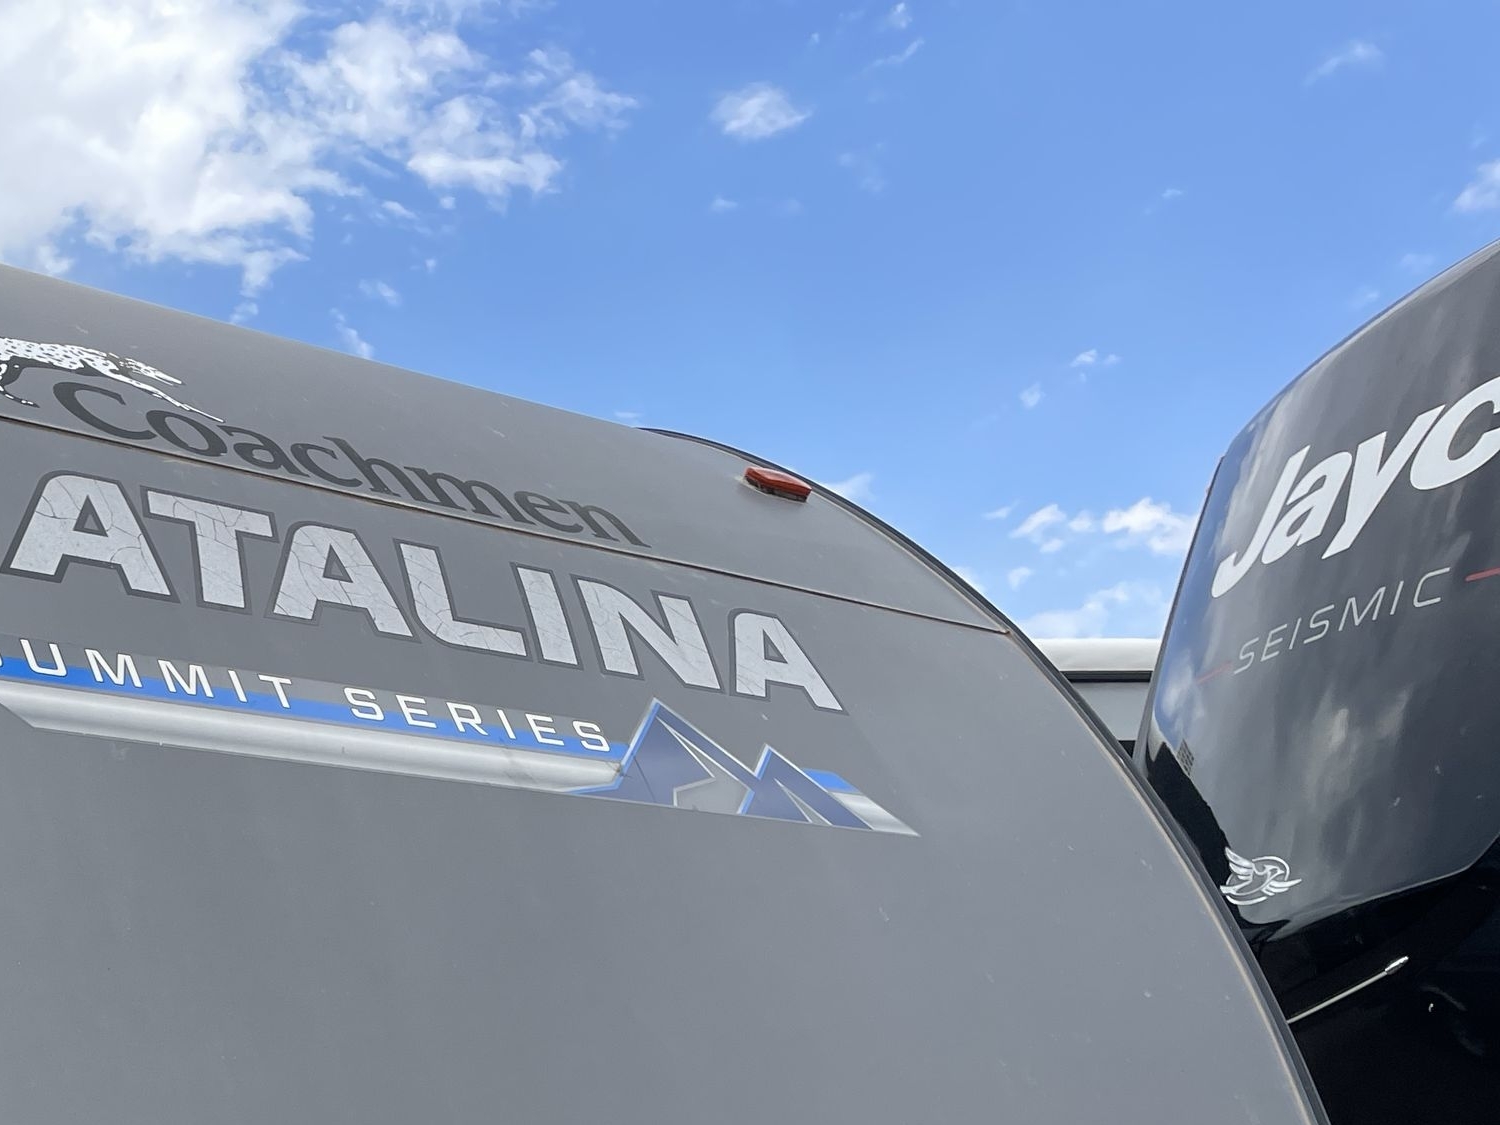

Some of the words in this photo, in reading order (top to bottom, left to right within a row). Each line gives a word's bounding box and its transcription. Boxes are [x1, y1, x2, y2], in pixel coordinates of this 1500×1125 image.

[52, 382, 652, 550] Coachmen
[1233, 567, 1452, 676] SEISMIC
[342, 686, 611, 754] SERIES
